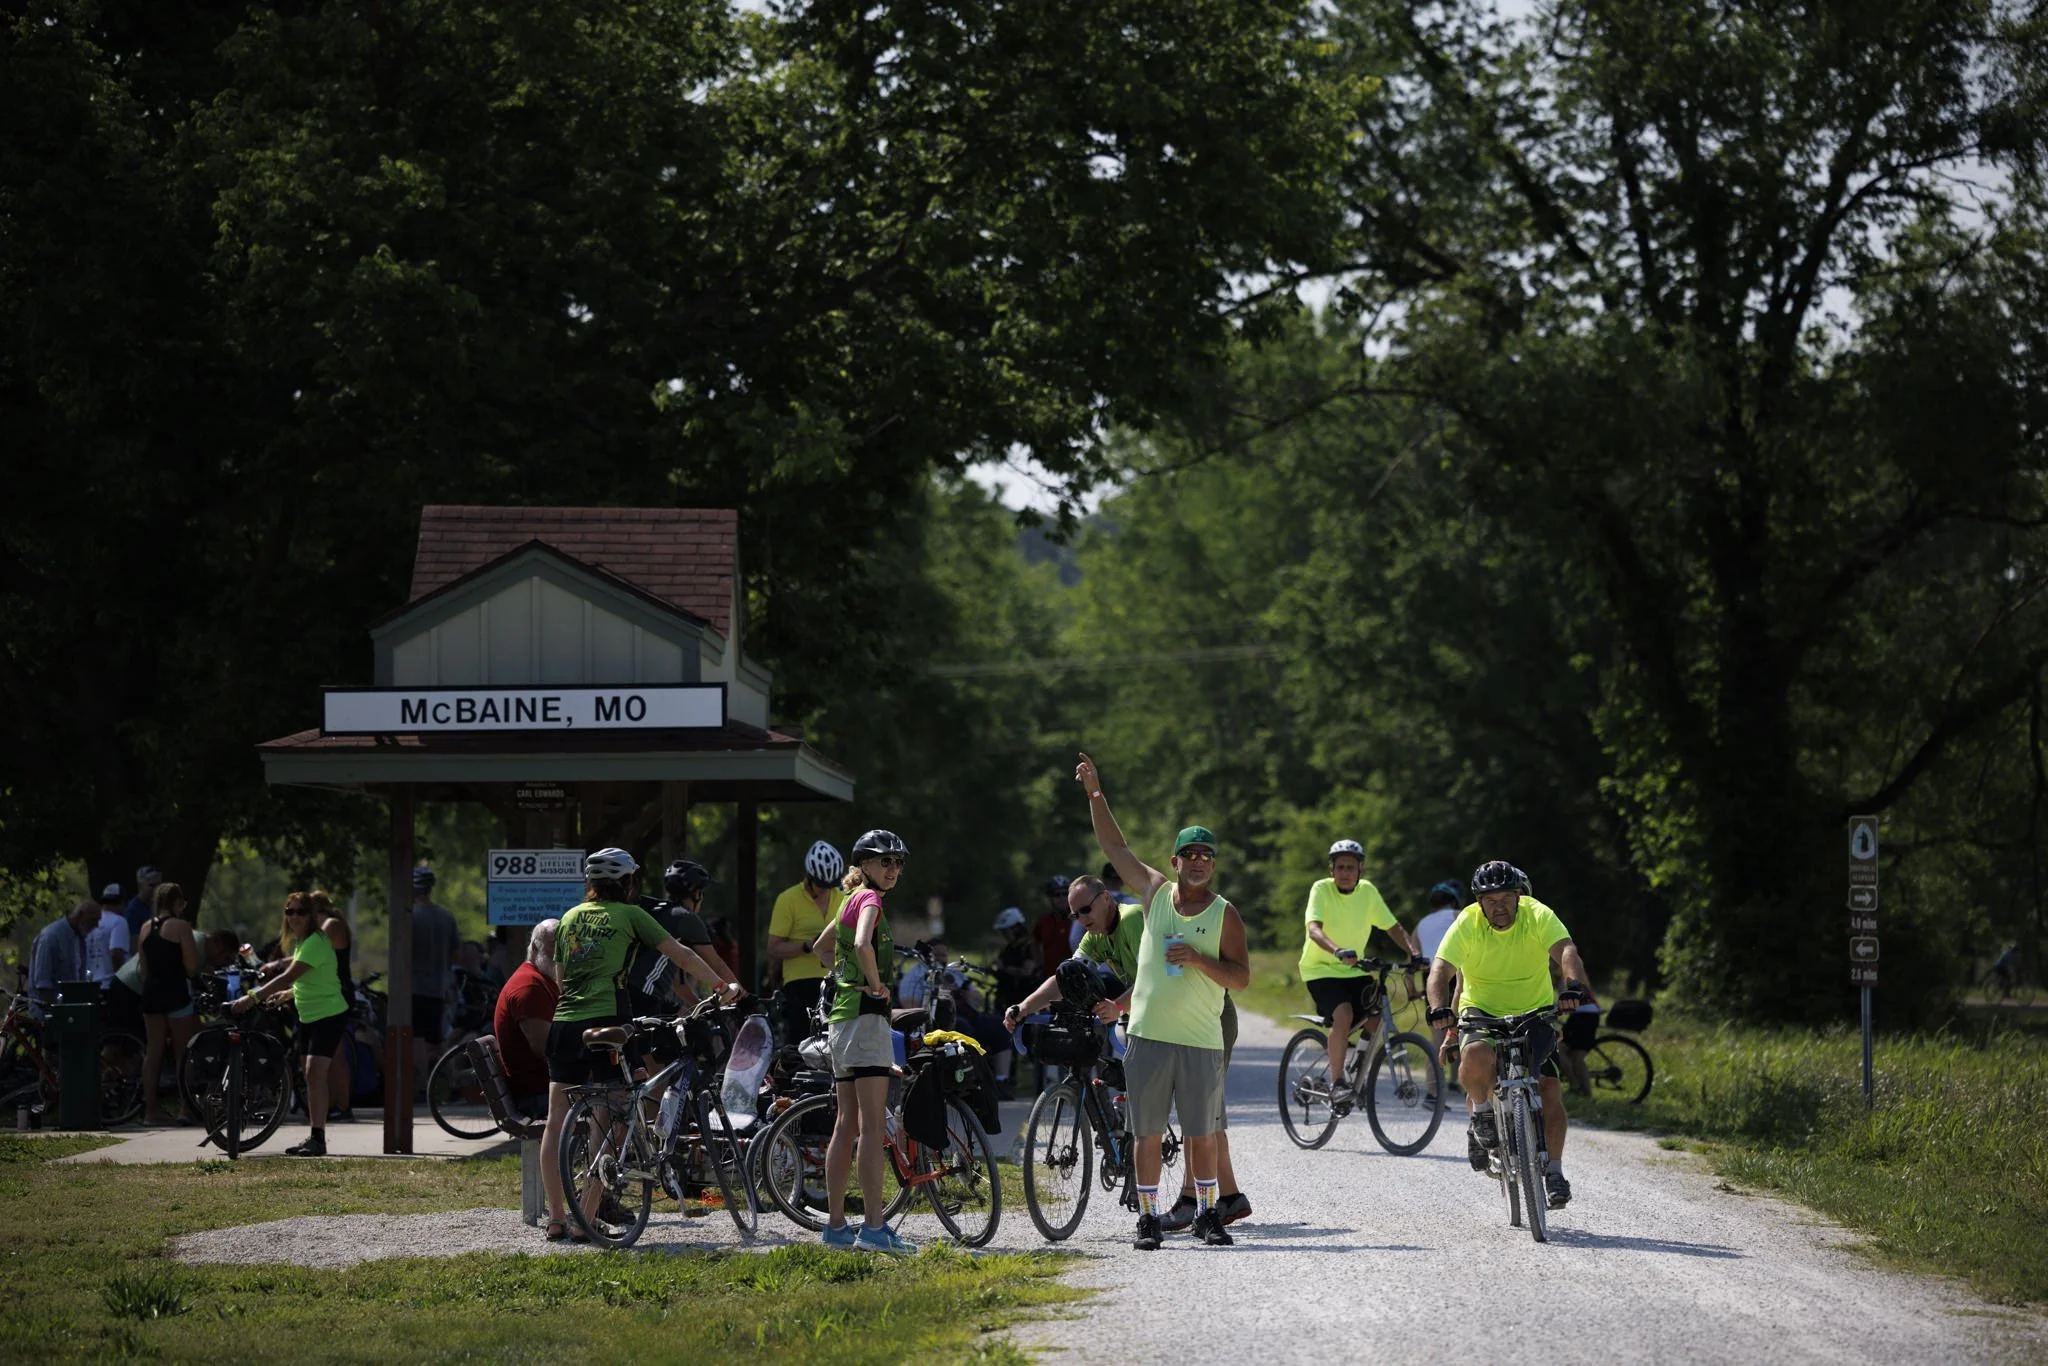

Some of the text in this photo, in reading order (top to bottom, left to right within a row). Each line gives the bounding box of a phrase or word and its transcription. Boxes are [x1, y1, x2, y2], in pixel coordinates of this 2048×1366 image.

[400, 694, 647, 727] McBAINE, MO
[516, 789, 565, 798] CARL EDWARDS
[494, 856, 537, 875] 988
[1862, 917, 1877, 929] miles
[1863, 969, 1878, 981] miles
